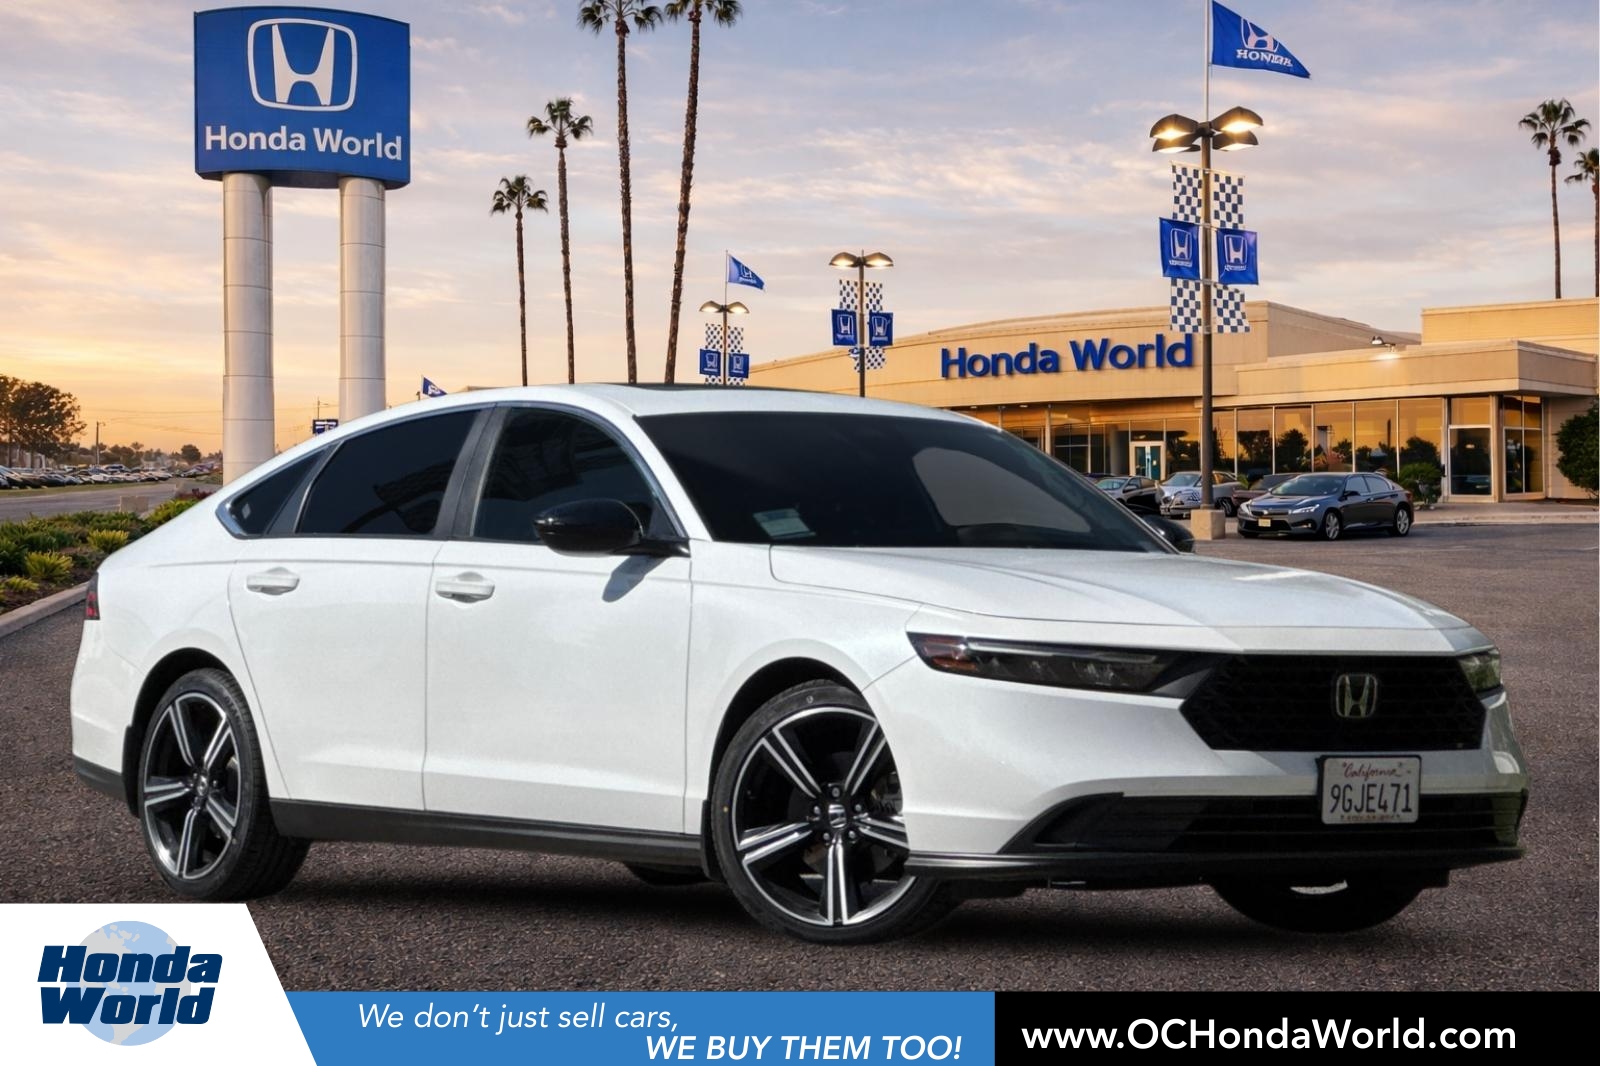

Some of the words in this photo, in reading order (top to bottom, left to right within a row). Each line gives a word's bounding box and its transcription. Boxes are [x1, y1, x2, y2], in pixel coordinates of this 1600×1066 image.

[205, 125, 306, 151] Honda
[313, 127, 402, 161] World
[941, 343, 1060, 378] Honda
[1070, 333, 1194, 371] World
[1330, 783, 1412, 813] 9GJE471
